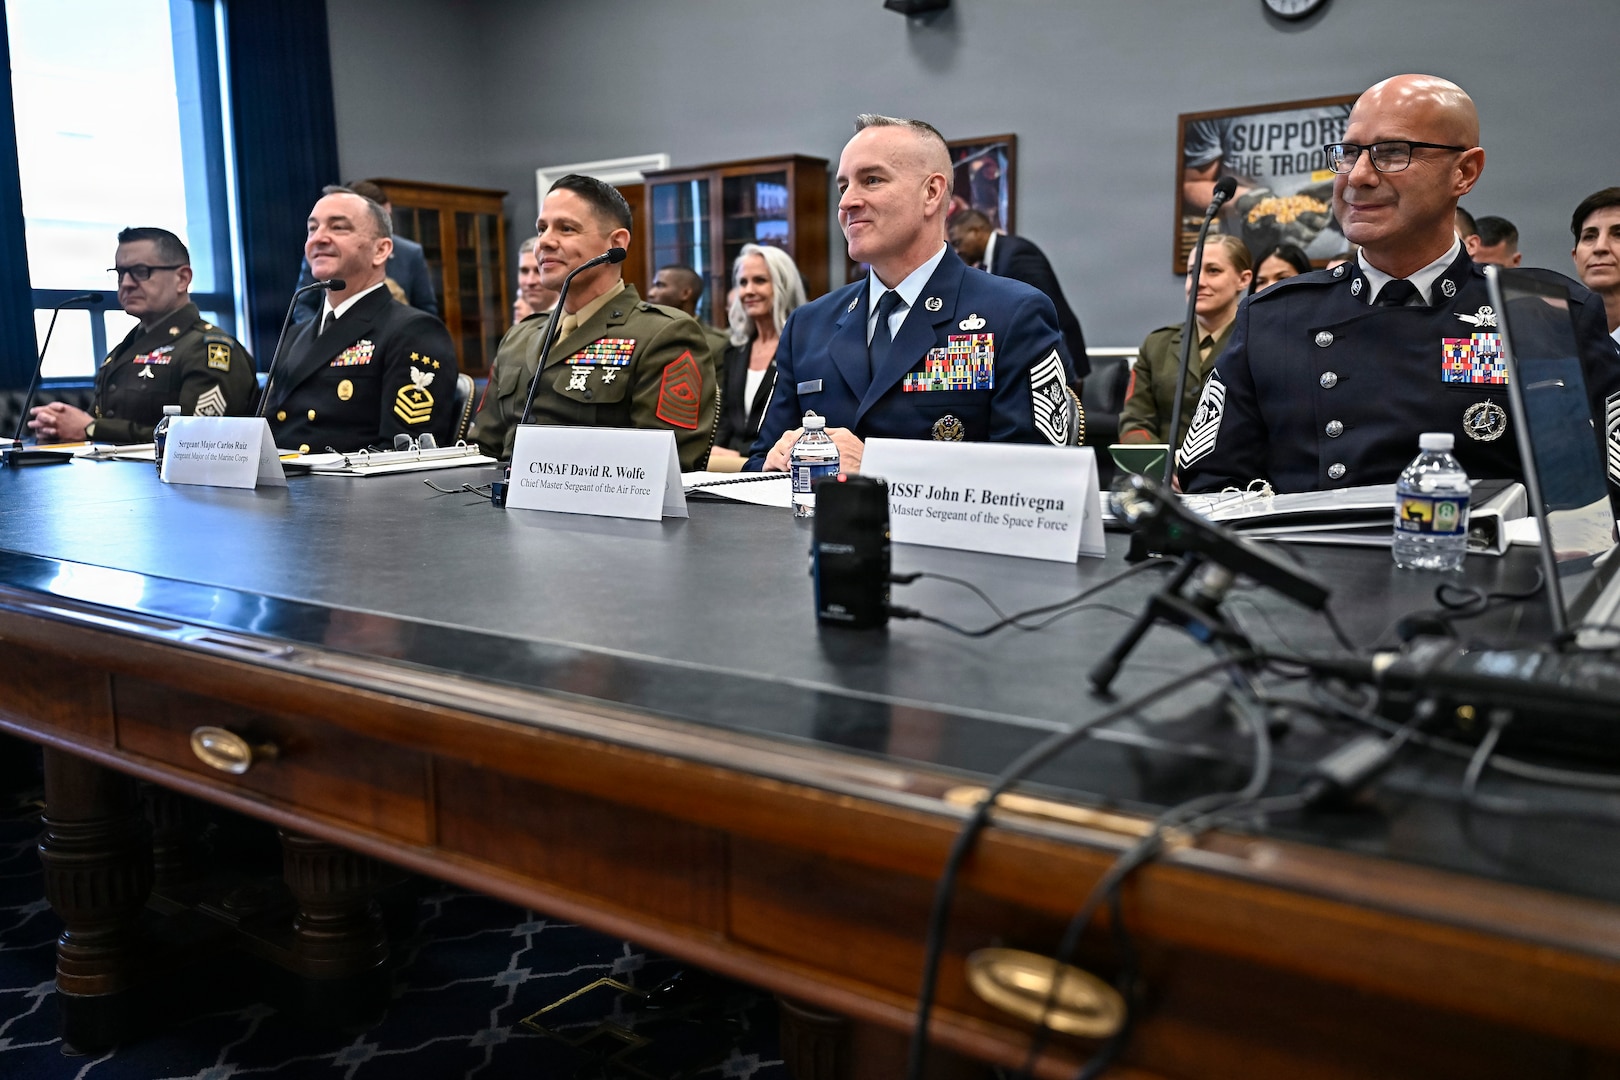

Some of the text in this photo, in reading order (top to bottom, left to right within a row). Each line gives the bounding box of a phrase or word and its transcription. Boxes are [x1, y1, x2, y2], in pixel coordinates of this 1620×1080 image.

[1233, 116, 1348, 152] SUPPORT
[1231, 154, 1263, 178] THE
[178, 440, 248, 451] Sergeant Major Carlos Ruiz
[173, 451, 248, 463] Sergeant Major of the Marine Corps
[529, 461, 646, 480] CMSAF David R. Wolfe
[520, 478, 651, 496] Chief Master Sergeant of the Air Force
[887, 482, 1064, 514] MSSF John F. Bentivegna
[891, 503, 924, 517] Master
[925, 506, 967, 522] Sergeant
[970, 511, 983, 523] of
[983, 512, 1000, 524] the
[1001, 513, 1034, 529] Space
[1036, 516, 1068, 531] Force
